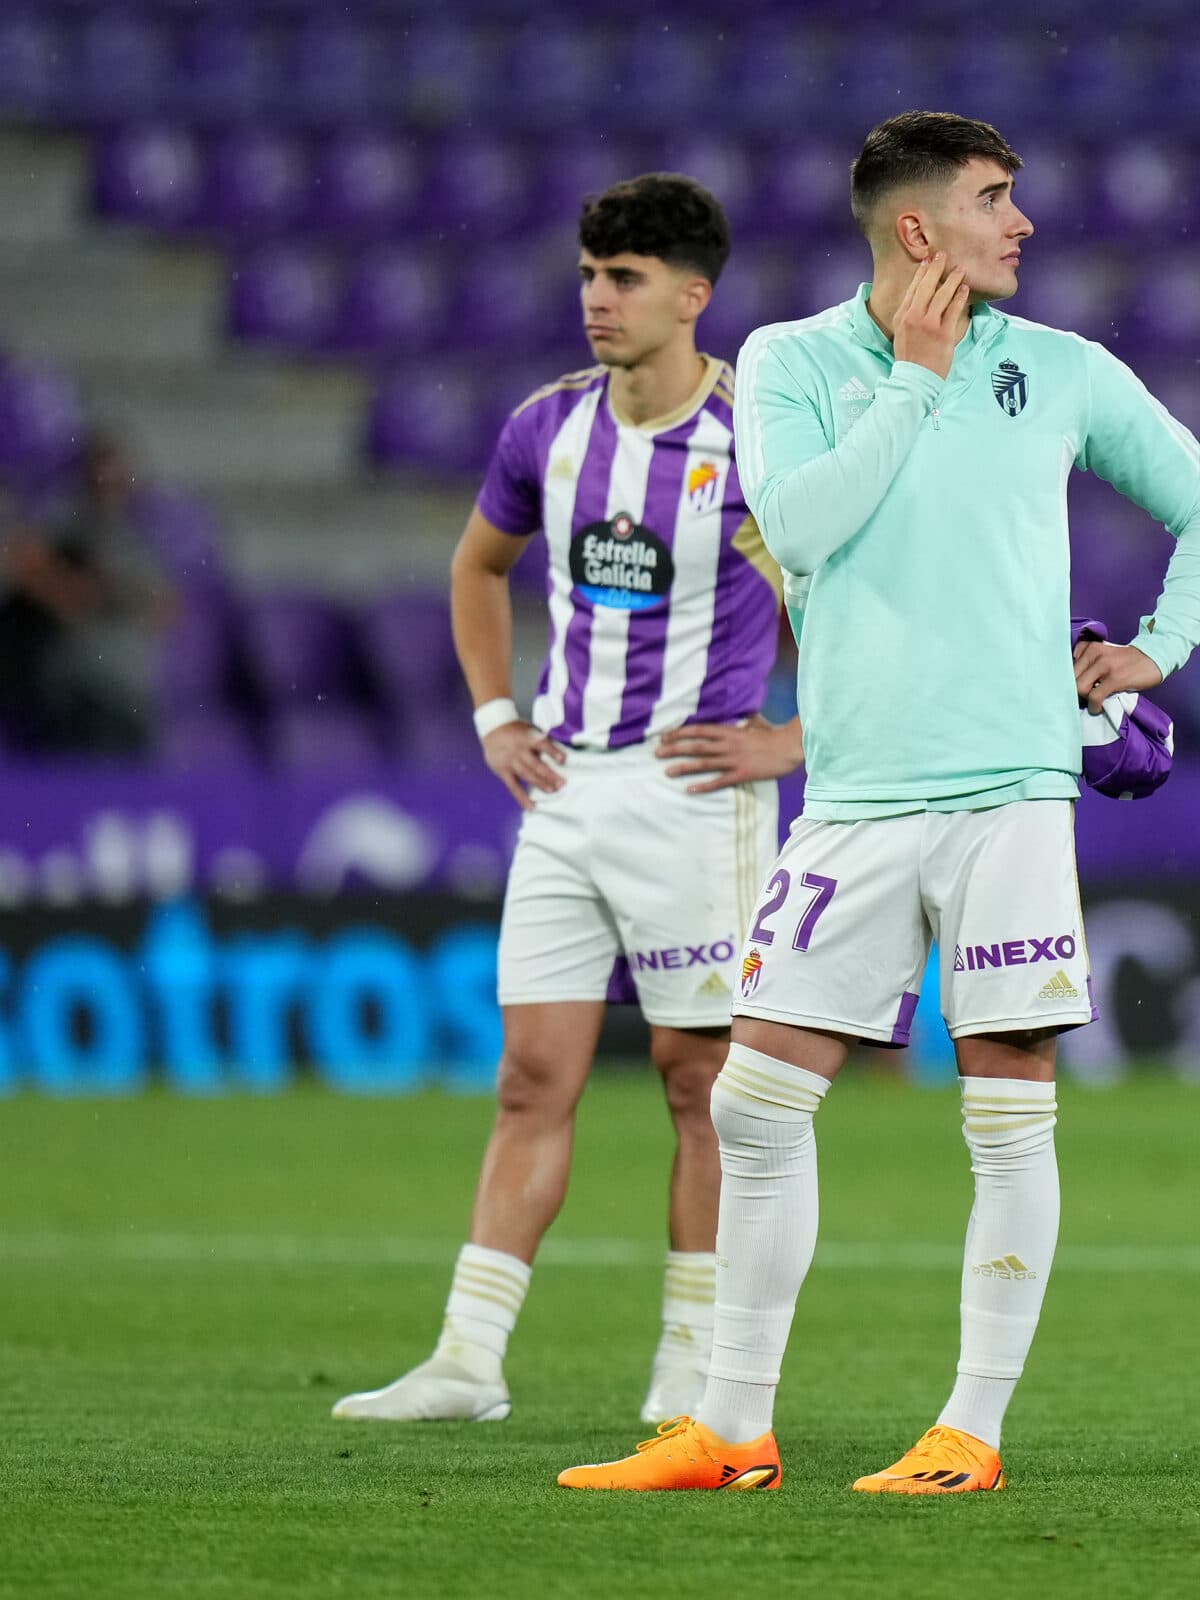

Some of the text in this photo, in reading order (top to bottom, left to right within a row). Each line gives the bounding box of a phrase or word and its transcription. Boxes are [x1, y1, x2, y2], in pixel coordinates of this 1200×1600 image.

[582, 533, 658, 569] Estrella
[584, 559, 652, 592] Galicia
[749, 868, 838, 953] 27
[965, 934, 1076, 971] INEXO
[0, 885, 503, 1096] otros
[1038, 987, 1078, 999] adidas
[972, 1265, 1037, 1281] adidas
